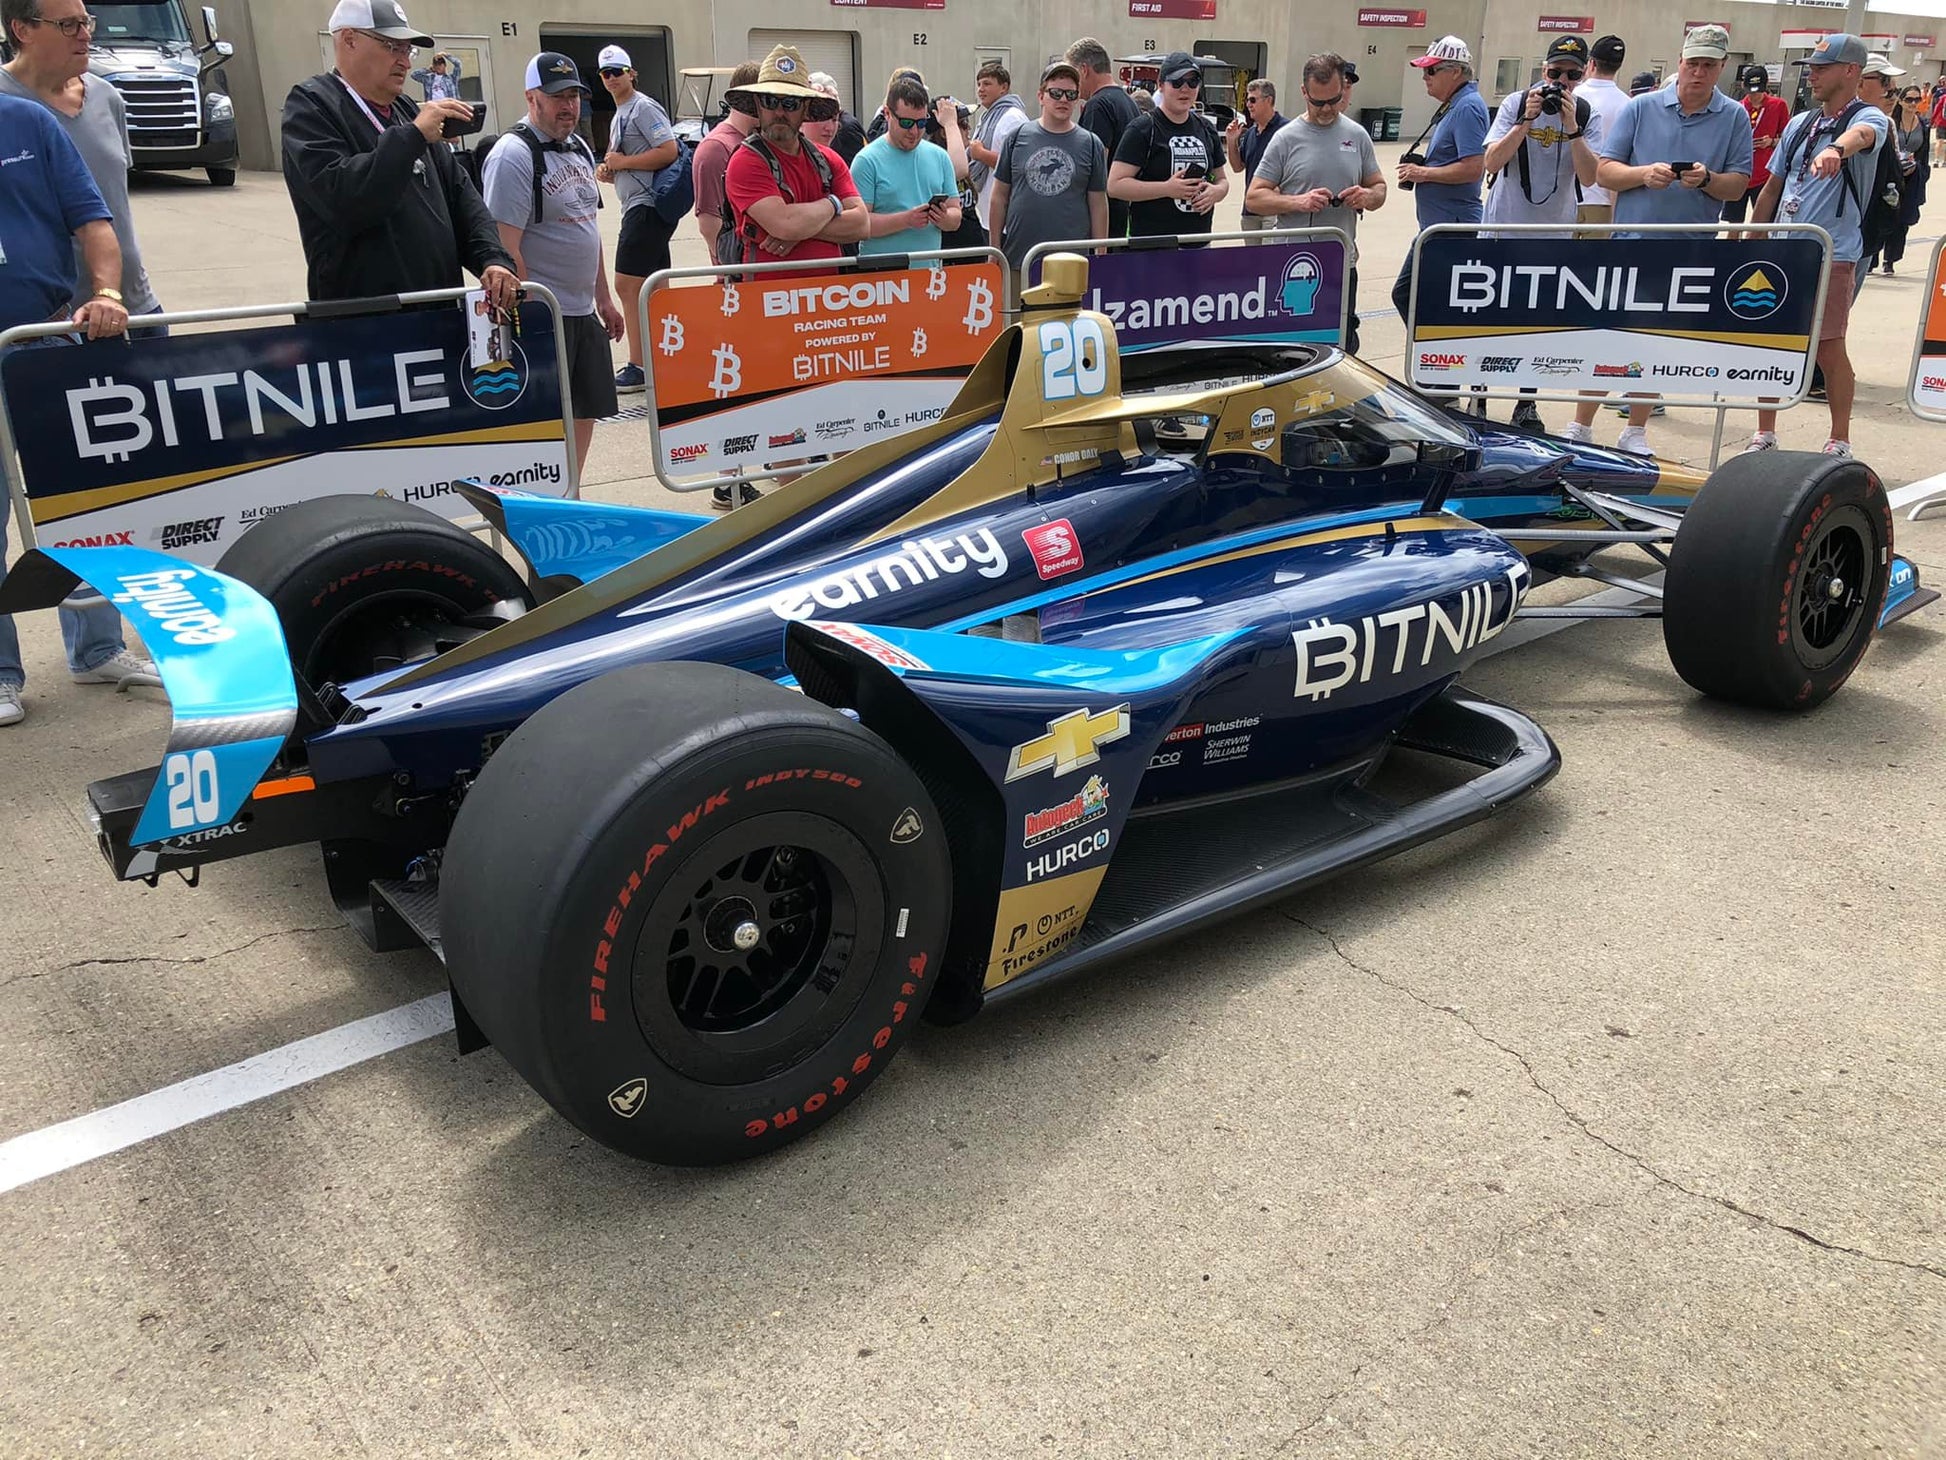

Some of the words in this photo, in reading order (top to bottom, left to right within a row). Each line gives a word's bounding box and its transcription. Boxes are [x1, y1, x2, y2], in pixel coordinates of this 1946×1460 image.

[1131, 3, 1149, 12] FIRST
[1150, 3, 1162, 13] AID
[502, 22, 517, 36] E1
[913, 33, 928, 46] E2
[1144, 40, 1156, 51] E3
[1367, 45, 1377, 55] E4
[763, 279, 910, 318] BITCOIN
[794, 317, 848, 333] RACING
[849, 313, 887, 327] TEAM
[805, 334, 860, 349] POWERED
[862, 331, 876, 342] BY
[793, 346, 890, 381] BITNILE
[1039, 317, 1107, 401] 20
[1420, 354, 1466, 365] SONAX
[1482, 356, 1524, 366] DIRECT
[1653, 365, 1720, 378] HURCO
[1727, 365, 1795, 386] earnity
[1480, 364, 1517, 374] SUPPLY
[65, 348, 451, 464] BITNILE
[864, 417, 900, 433] BITNILE
[671, 443, 708, 459] SONAX
[723, 433, 760, 448] DIRECT
[723, 444, 755, 456] SUPPLY
[1054, 450, 1081, 465] CONOR
[1081, 448, 1098, 460] DALY
[489, 462, 561, 487] earnity
[162, 516, 225, 539] DIRECT
[161, 531, 220, 550] SUPPLY
[771, 527, 1010, 620] earnity
[1042, 557, 1080, 573] Speedway
[112, 569, 238, 646] earnity
[1204, 715, 1261, 735] Industries
[1203, 743, 1250, 760] WILLIAMS
[1206, 734, 1252, 750] SHERWIN
[166, 749, 219, 830] 20
[1026, 795, 1085, 837] Autogeek
[177, 821, 248, 848] XTRAC
[1026, 828, 1110, 882] HURCO
[590, 787, 732, 1022] FIREHAWK
[1001, 926, 1078, 976] Firestone
[744, 951, 927, 1139] Firestone
